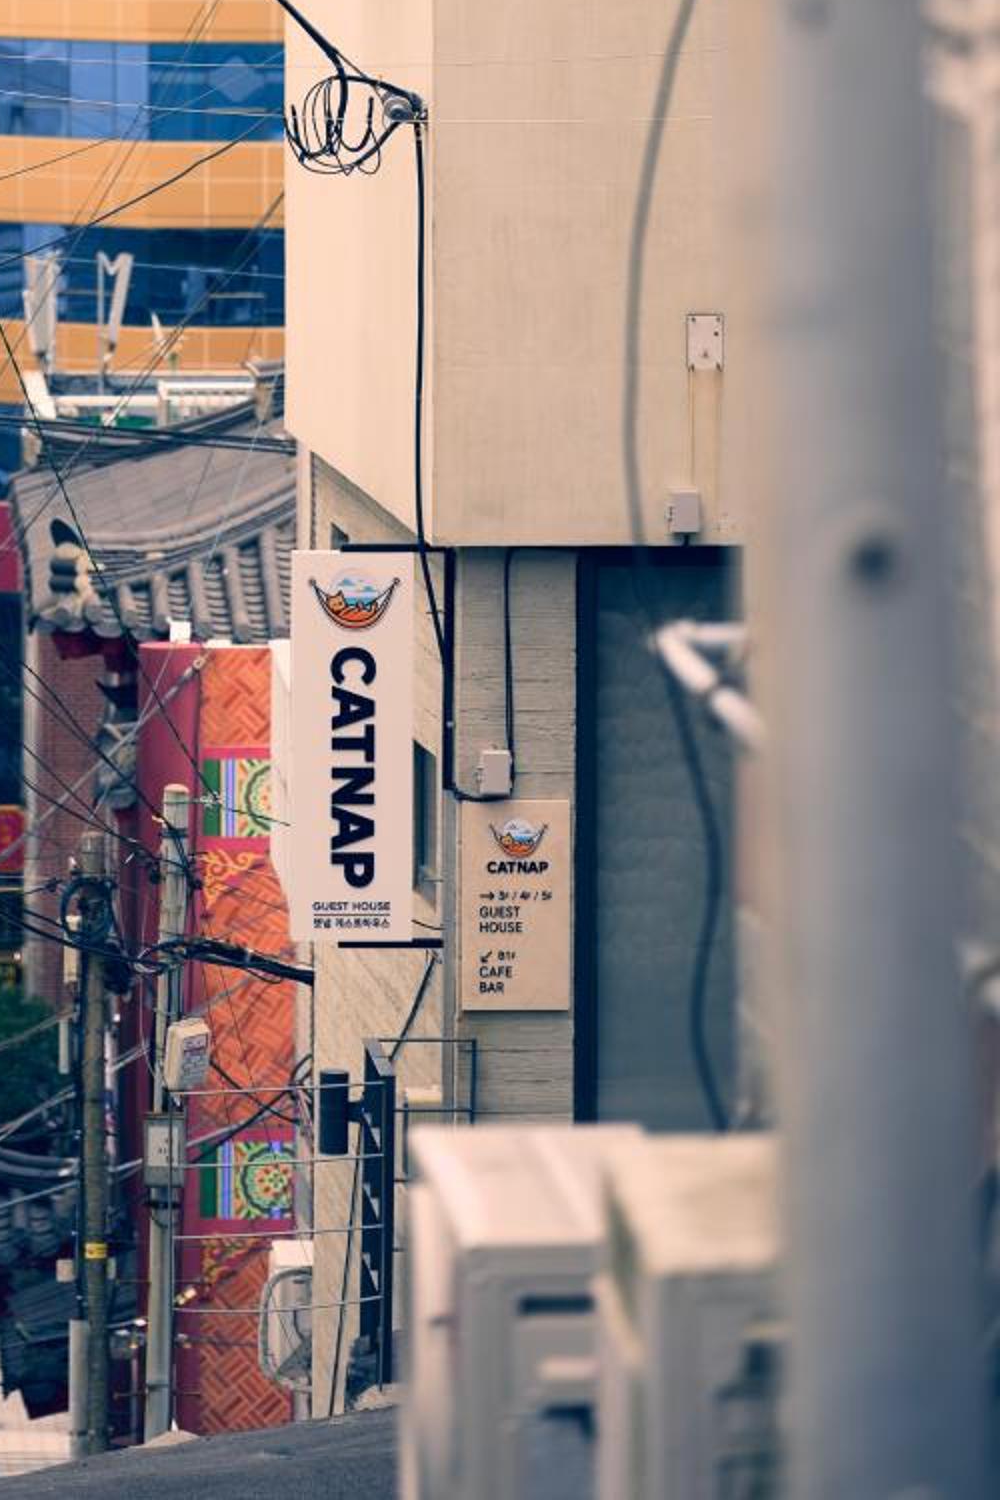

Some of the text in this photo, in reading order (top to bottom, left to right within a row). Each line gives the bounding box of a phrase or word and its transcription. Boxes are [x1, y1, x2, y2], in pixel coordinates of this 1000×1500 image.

[330, 646, 377, 888] CATNAP
[486, 861, 549, 874] CATNAP
[312, 901, 391, 911] GUEST HOUSE
[479, 905, 520, 918] GUEST
[479, 921, 523, 934] HOUSE
[479, 965, 513, 979] CAFE
[479, 981, 505, 993] BAR
